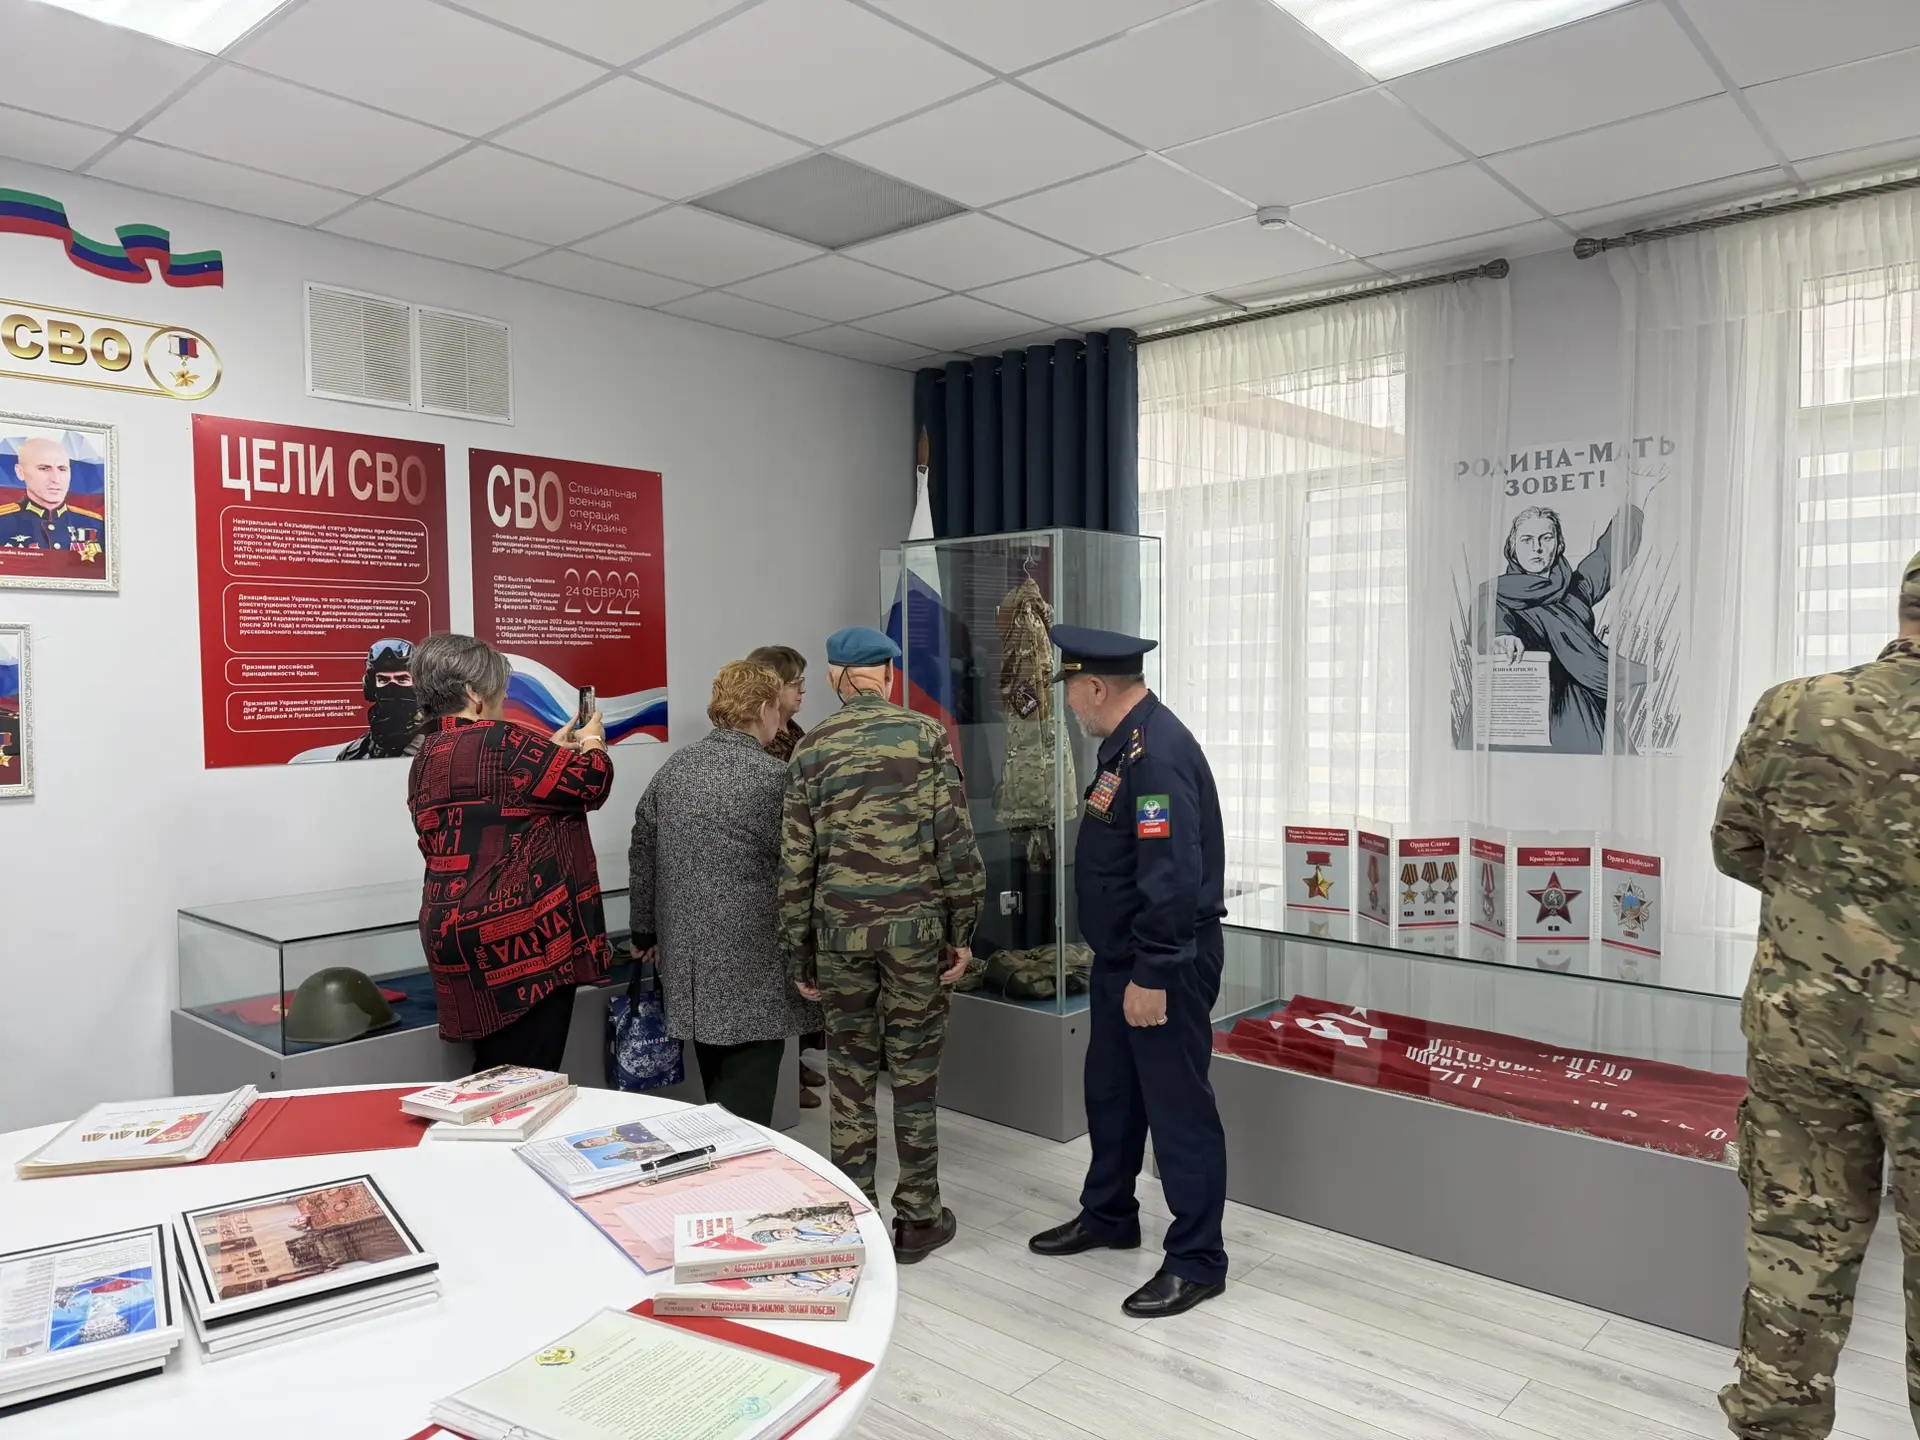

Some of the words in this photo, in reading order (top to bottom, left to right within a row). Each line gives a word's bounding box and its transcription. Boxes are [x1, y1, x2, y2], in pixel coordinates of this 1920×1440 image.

[1, 314, 132, 372] СВО
[1455, 436, 1675, 480] РОДИНА-МТЬ
[220, 434, 335, 501] ЦЕЛИ
[348, 449, 428, 505] СВО
[568, 482, 637, 500] Специальная
[1504, 470, 1606, 496] ЗОВЕТ!
[487, 464, 564, 532] СВО
[569, 496, 612, 509] военная
[570, 508, 620, 523] операция
[570, 521, 582, 531] на
[584, 521, 628, 535] Украине
[564, 568, 640, 615] 2022
[566, 586, 580, 597] 24
[582, 587, 640, 598] ФЕВРАЛЯ
[1606, 854, 1624, 863] Орден
[1626, 858, 1654, 868] «Победа»
[831, 1253, 855, 1263] ПОБЕДЫ
[810, 1305, 836, 1315] ПОБЕДЫ
